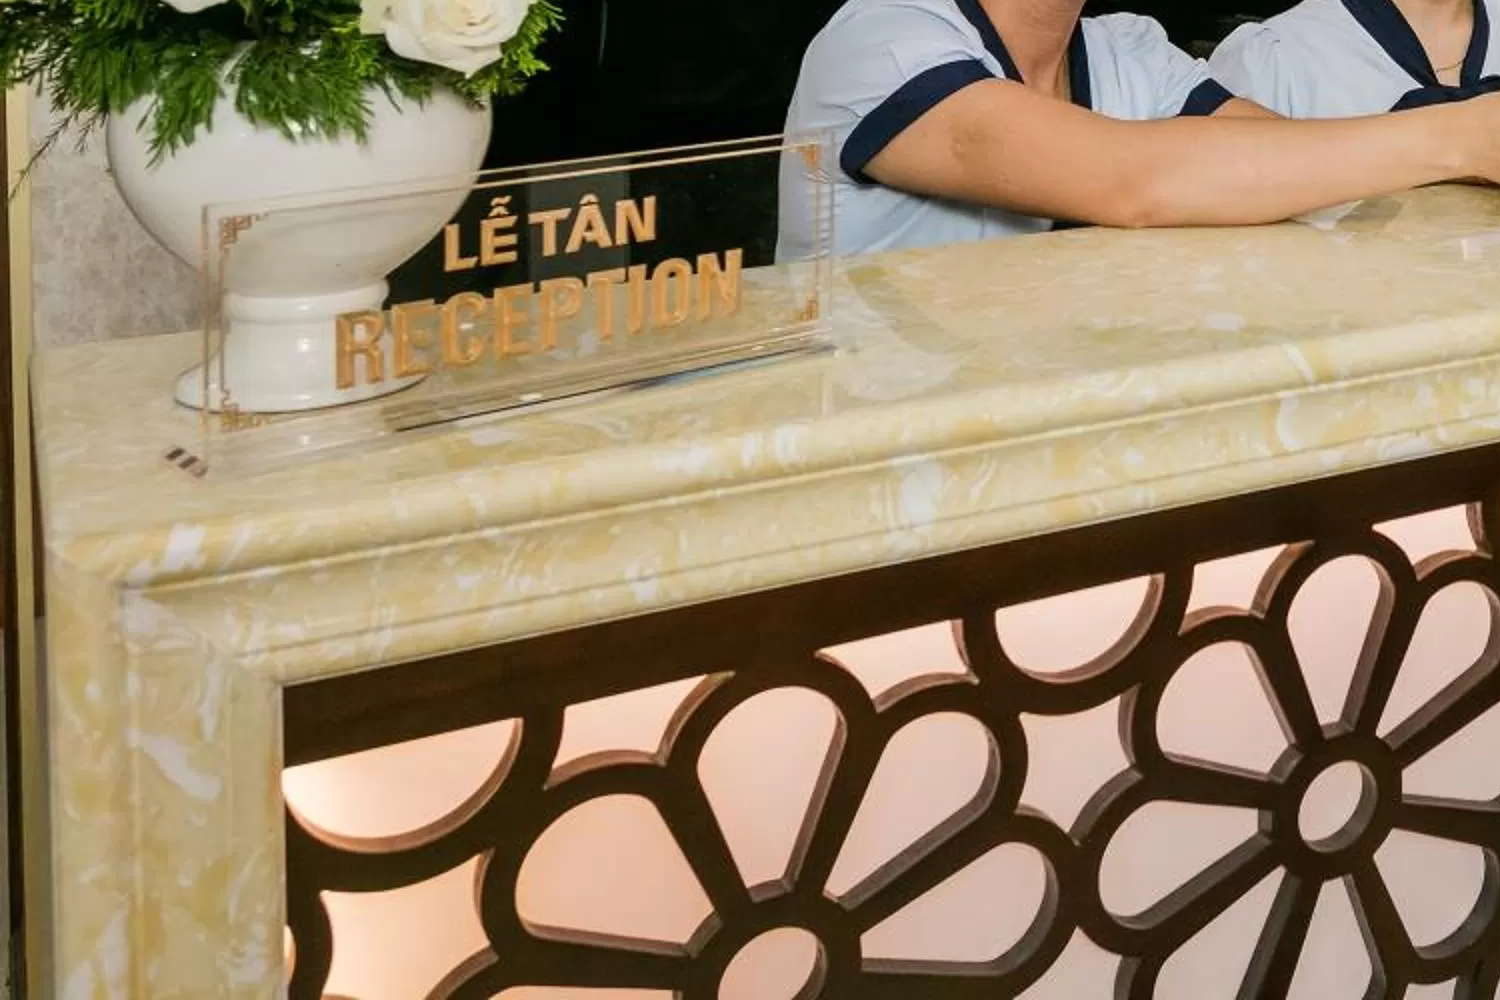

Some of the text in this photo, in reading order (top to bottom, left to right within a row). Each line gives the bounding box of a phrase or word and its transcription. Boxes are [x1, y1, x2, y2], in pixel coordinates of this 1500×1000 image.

[443, 193, 657, 272] LỄ TÂN
[335, 247, 743, 390] RECEPTION
